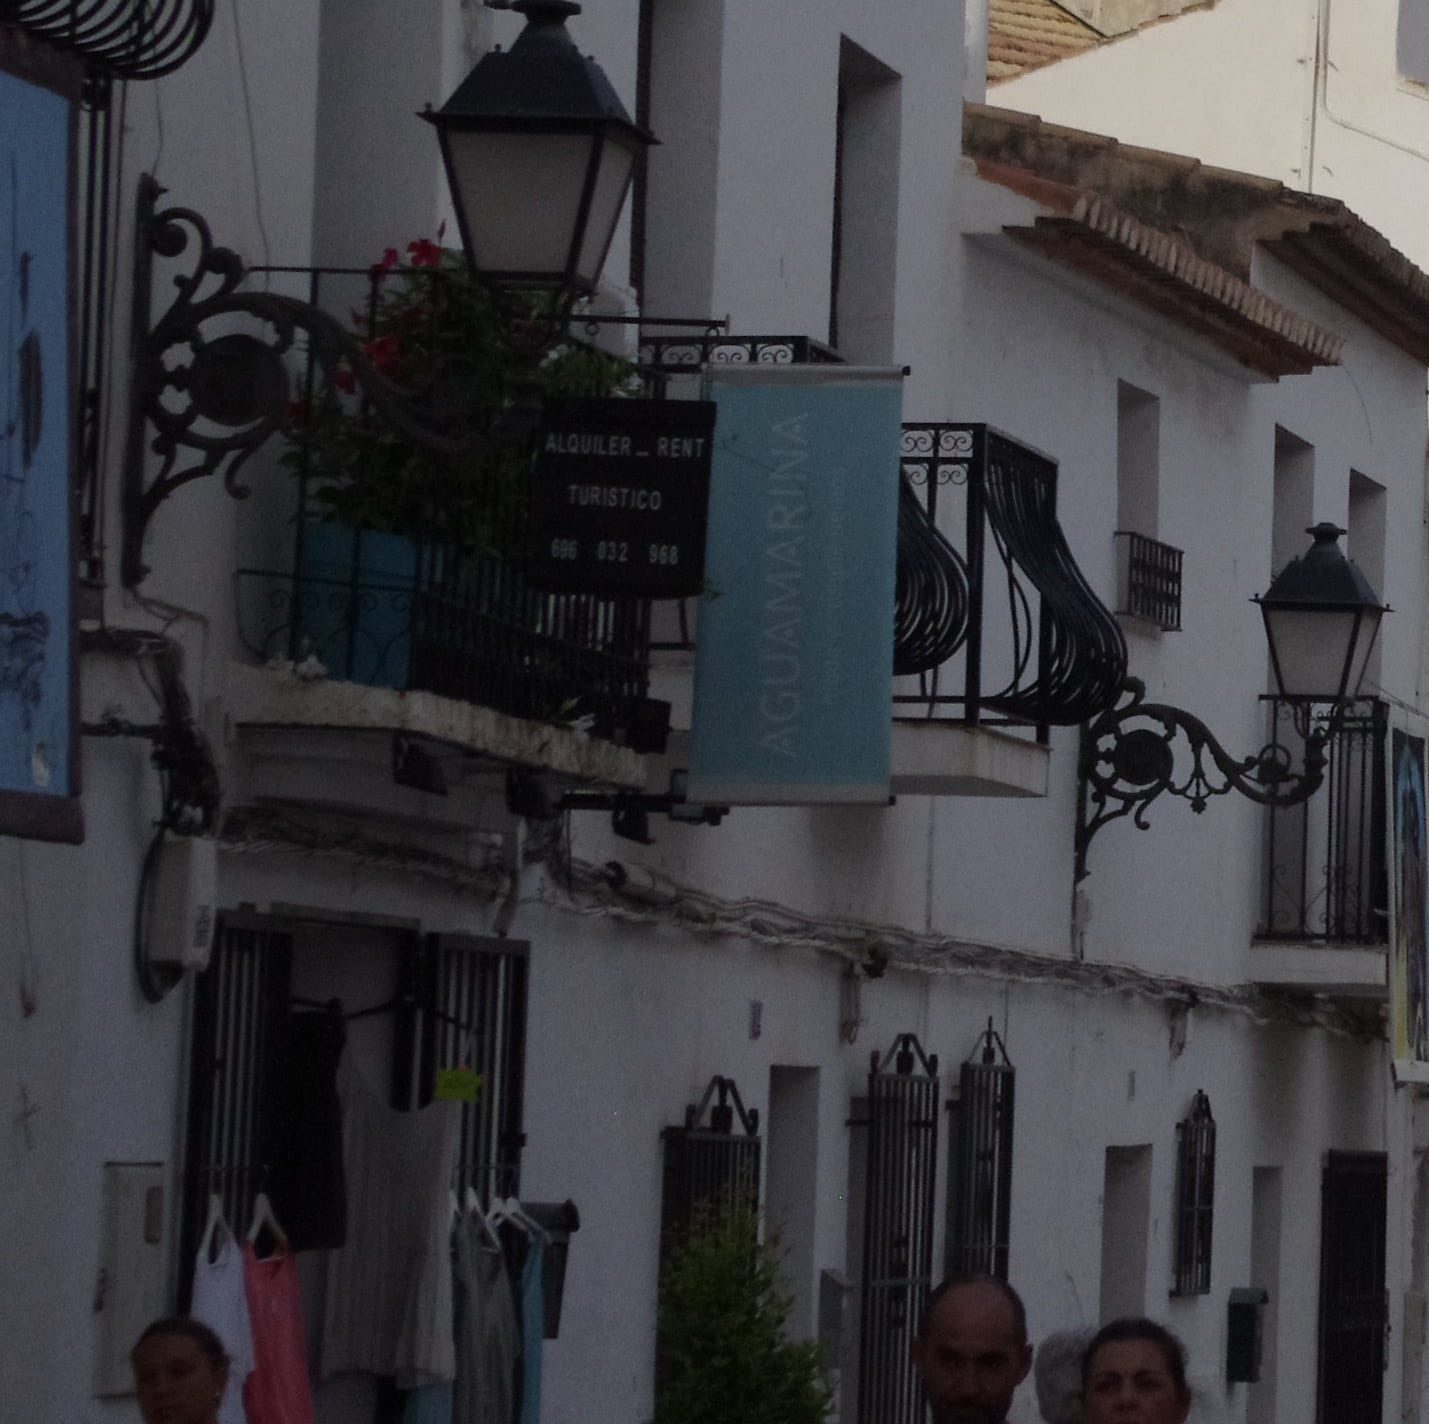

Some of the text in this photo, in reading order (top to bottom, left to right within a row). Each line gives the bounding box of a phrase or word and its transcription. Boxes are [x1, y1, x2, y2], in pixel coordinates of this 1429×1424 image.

[544, 432, 632, 457] ALQUILER
[656, 436, 706, 458] RENT
[567, 484, 663, 512] TURISTICO
[597, 540, 630, 563] 032
[649, 543, 680, 566] 968
[757, 412, 810, 762] AGUAMARINA
